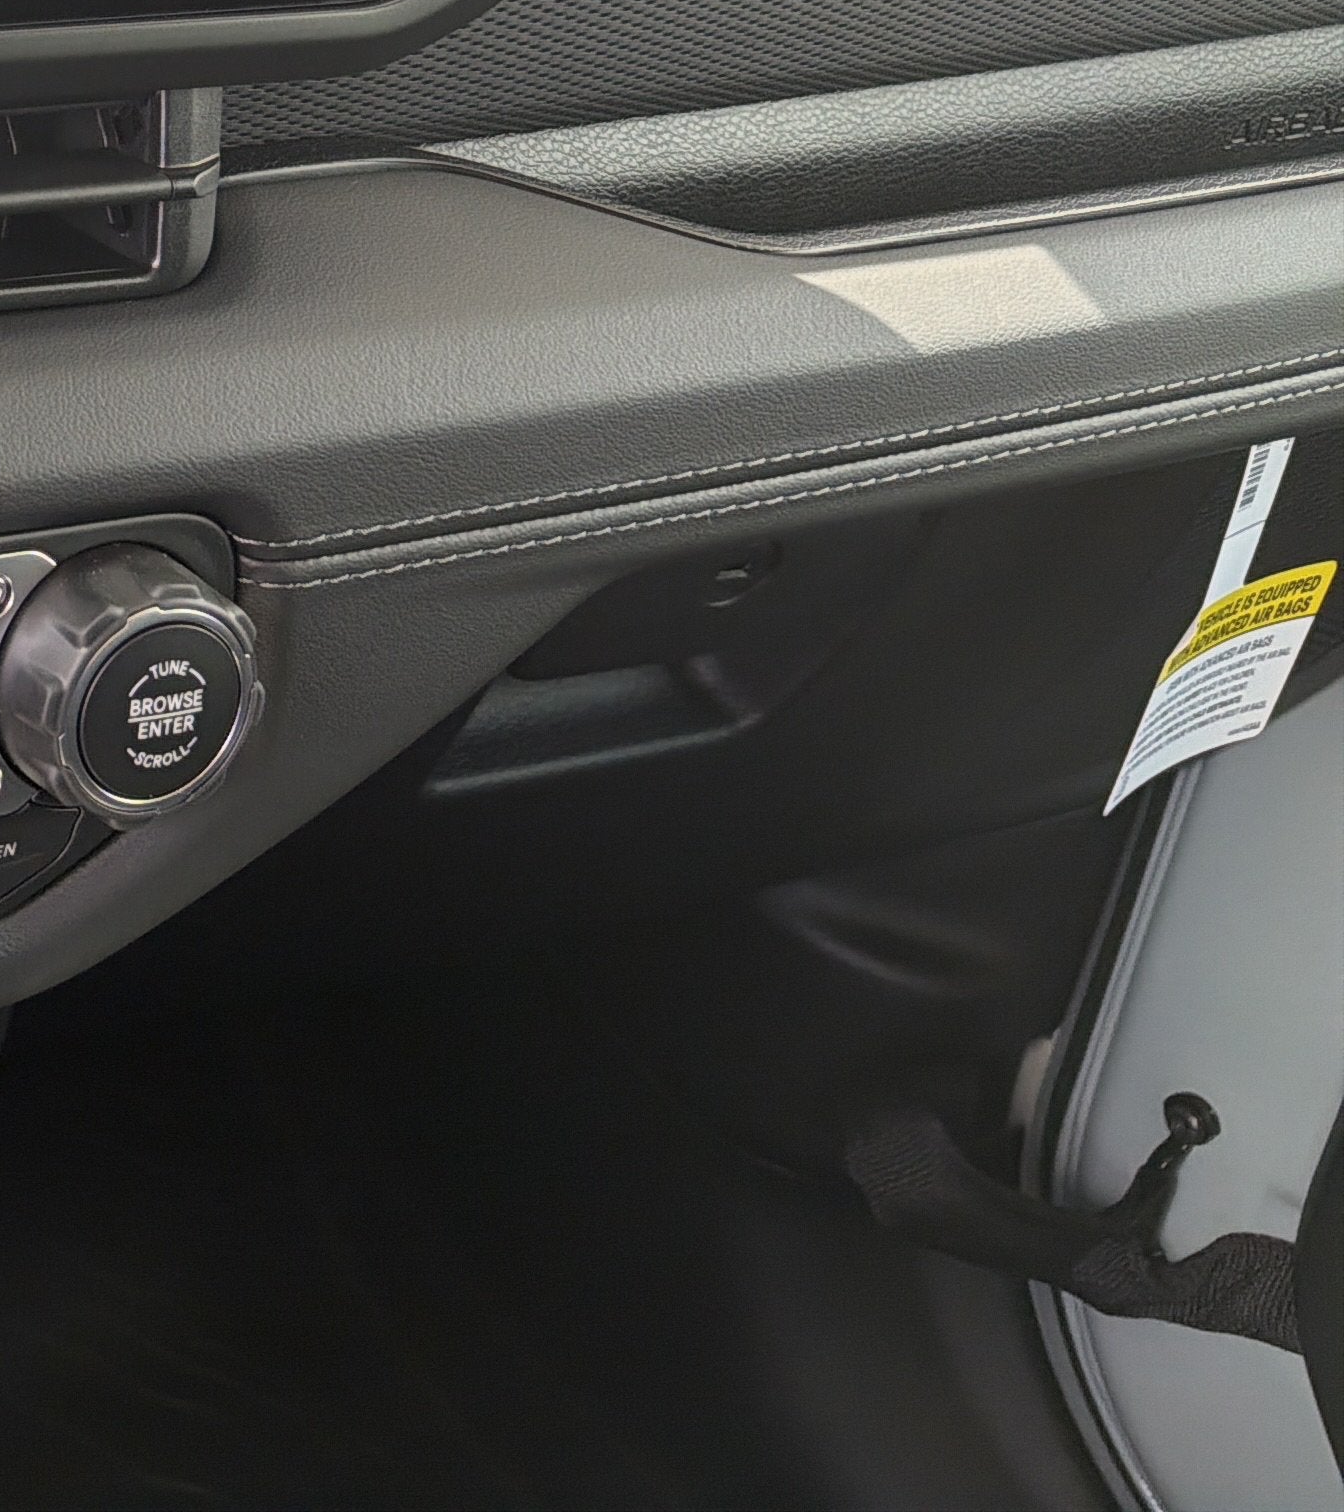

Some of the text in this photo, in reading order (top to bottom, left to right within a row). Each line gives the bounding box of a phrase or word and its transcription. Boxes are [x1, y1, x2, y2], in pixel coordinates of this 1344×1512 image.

[1241, 592, 1256, 610] IS
[1255, 574, 1322, 605] EQUIPPED
[1250, 605, 1274, 627] AIR
[1273, 596, 1313, 618] BAGS
[149, 659, 191, 680] TUNE
[129, 688, 203, 718] BROWSE
[137, 714, 195, 741] ENTER
[134, 744, 190, 769] SCROLL
